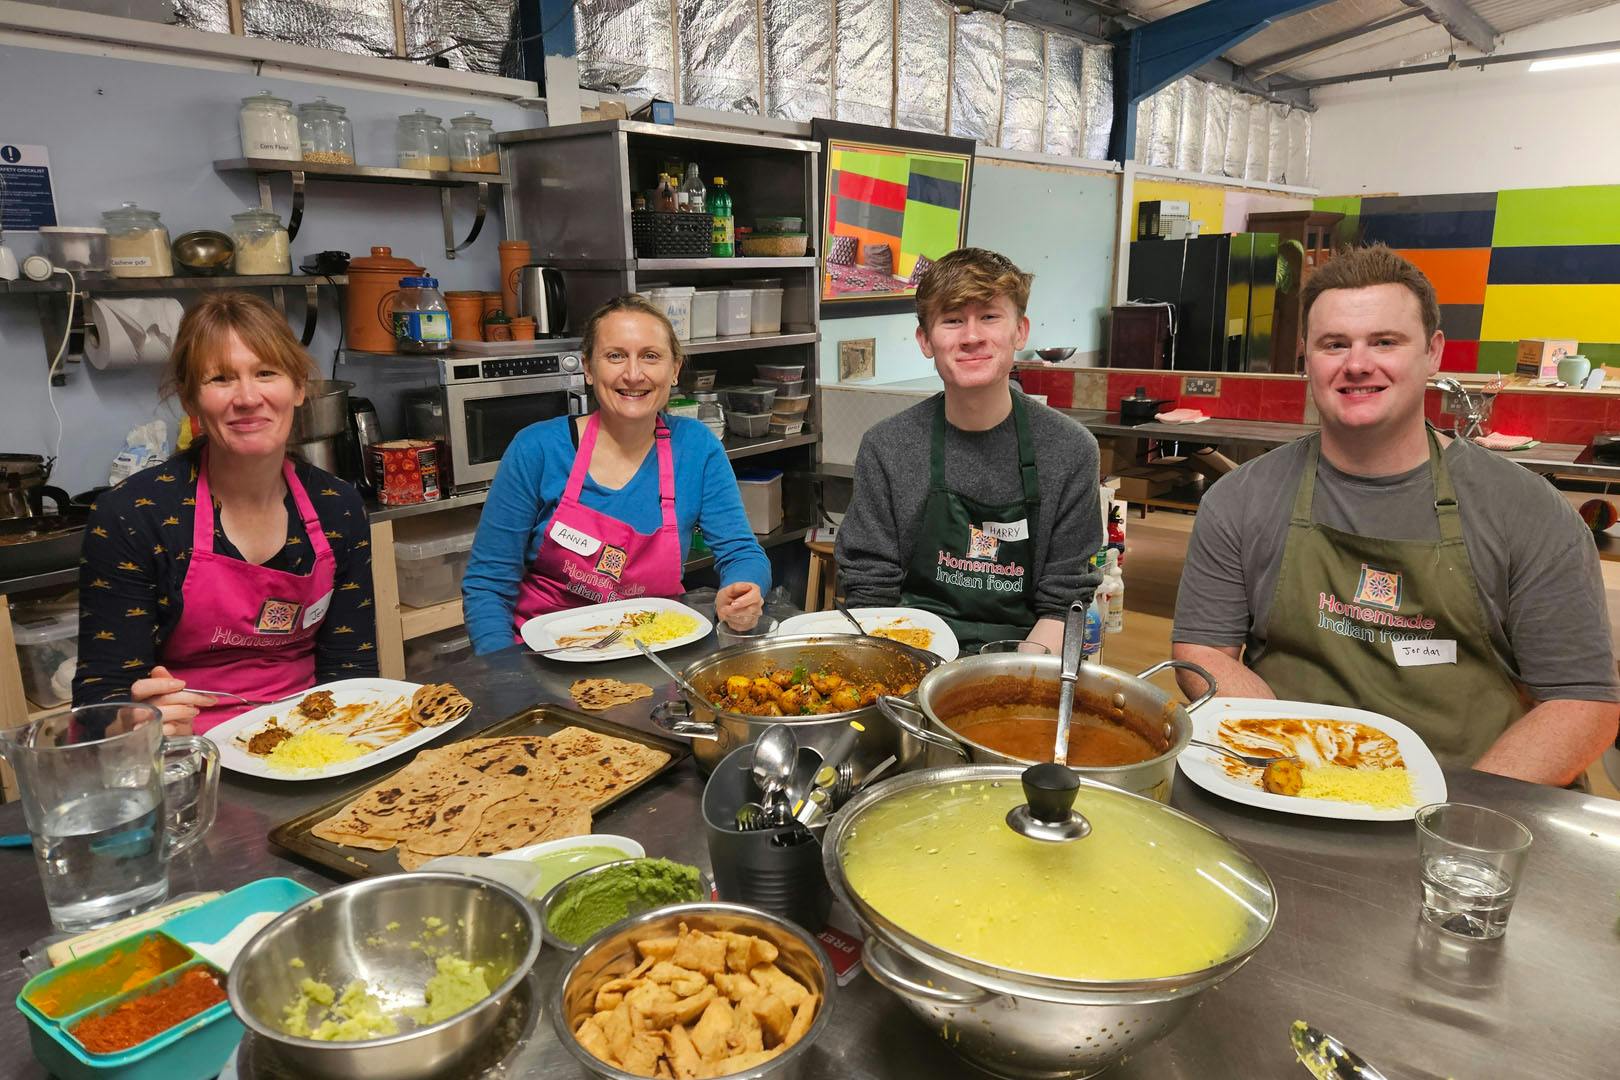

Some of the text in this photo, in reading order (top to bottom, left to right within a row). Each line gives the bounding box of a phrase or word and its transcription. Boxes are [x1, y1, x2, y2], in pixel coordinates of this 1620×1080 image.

[557, 528, 588, 548] ANNA
[990, 526, 1021, 537] HARRY
[937, 550, 1025, 576] Homemade
[562, 560, 646, 597] Homemde
[936, 566, 1024, 592] Indian food
[1318, 592, 1436, 630] Homemade
[1318, 611, 1375, 643] Indian
[1402, 646, 1441, 657] Jordan
